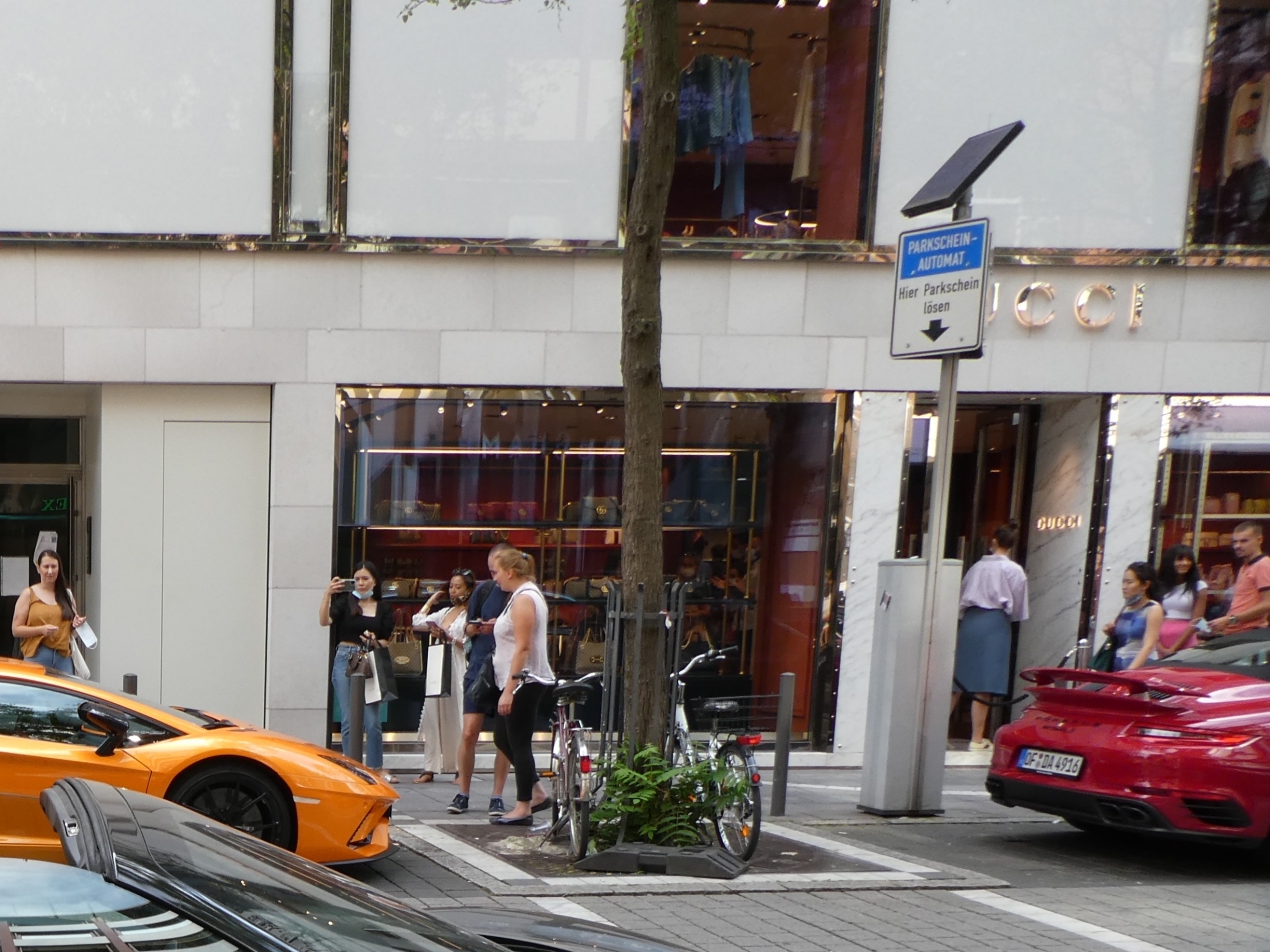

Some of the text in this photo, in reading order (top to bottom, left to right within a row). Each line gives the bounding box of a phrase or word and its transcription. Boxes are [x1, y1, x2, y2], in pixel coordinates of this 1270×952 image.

[908, 231, 978, 255] PARKSCHEIN-
[917, 251, 966, 272] AUTOMAT
[898, 277, 980, 300] Hier Parkschein
[923, 300, 950, 315] lösen
[987, 282, 1147, 329] CCI
[1036, 515, 1083, 530] GUCCI
